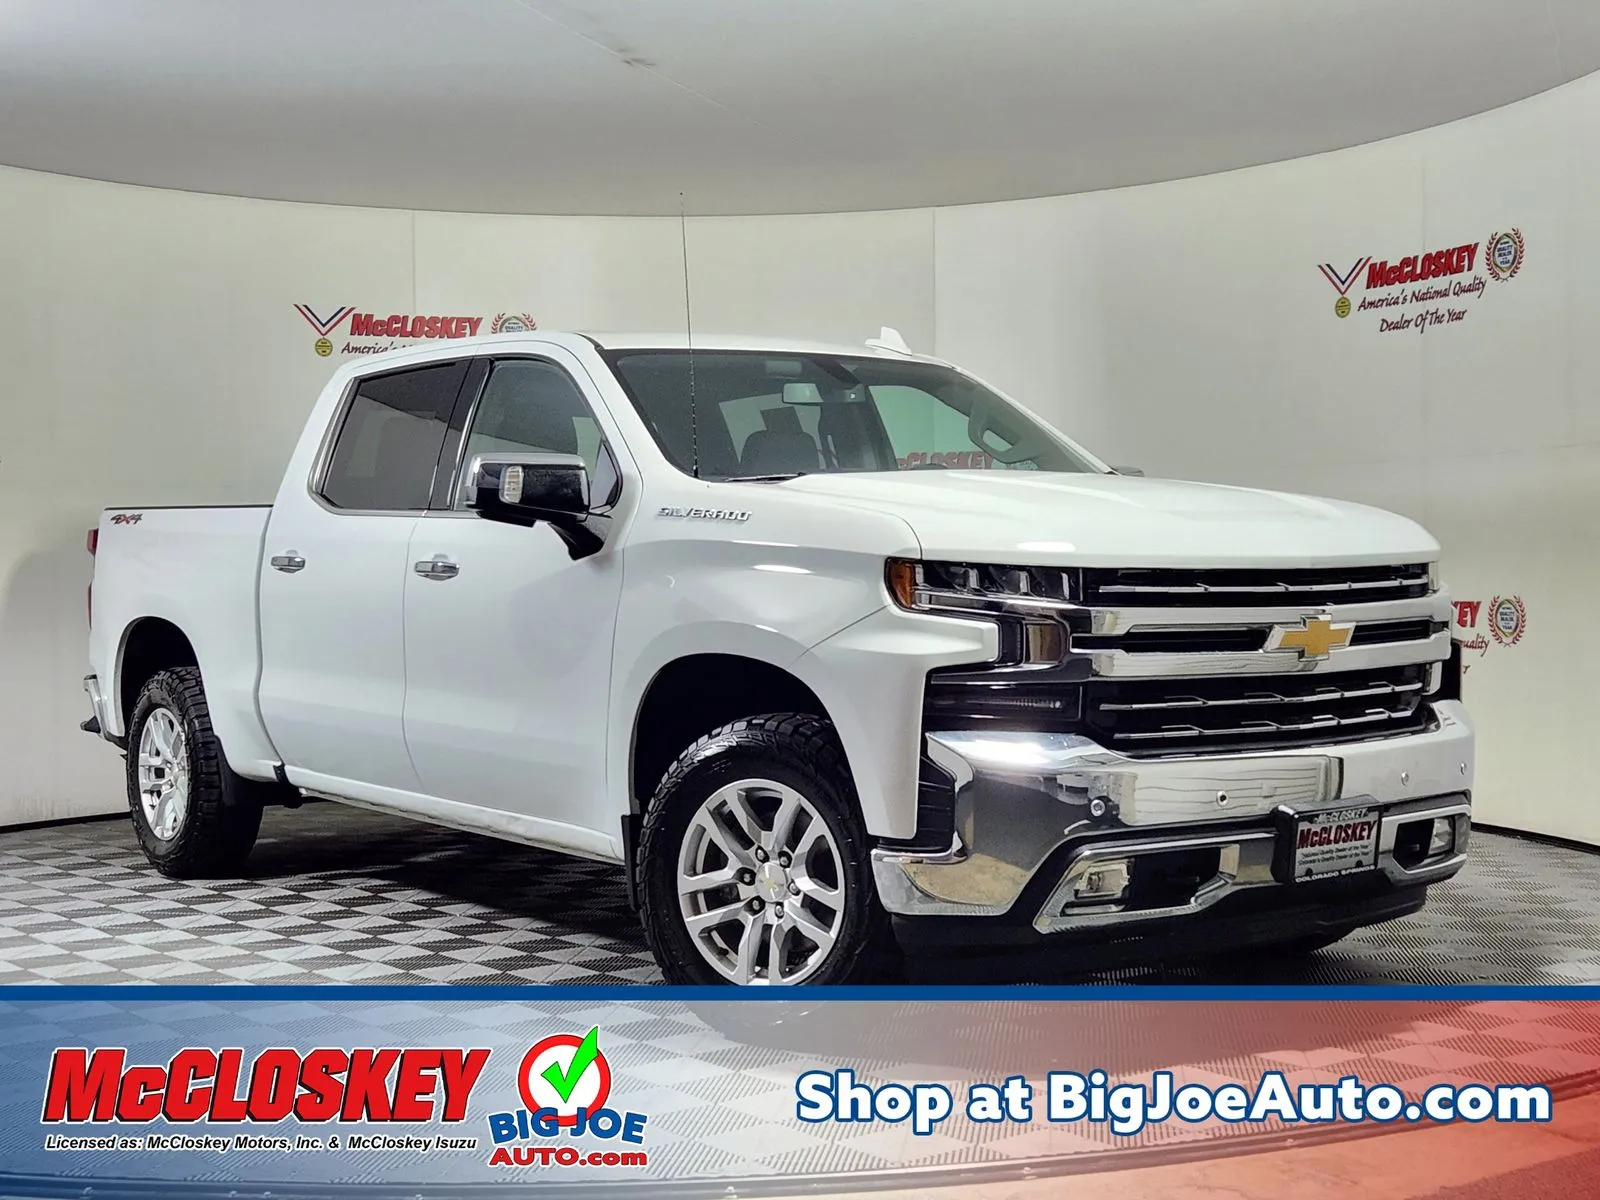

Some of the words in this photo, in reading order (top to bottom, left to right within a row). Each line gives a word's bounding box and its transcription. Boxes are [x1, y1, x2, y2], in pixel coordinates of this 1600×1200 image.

[1366, 242, 1480, 289] McCLOSKEY
[1357, 288, 1408, 312] America's
[1410, 280, 1453, 303] National
[1453, 275, 1487, 299] Quality
[350, 313, 483, 338] McCLOSKEY
[1380, 313, 1413, 332] Dealer
[1414, 310, 1429, 334] Of
[1428, 308, 1445, 325] The
[1446, 308, 1467, 325] Year
[657, 507, 752, 521] SILVERADO
[1462, 633, 1489, 657] uality
[1296, 820, 1377, 849] McCLOSKEY
[1295, 871, 1339, 883] COLORADO
